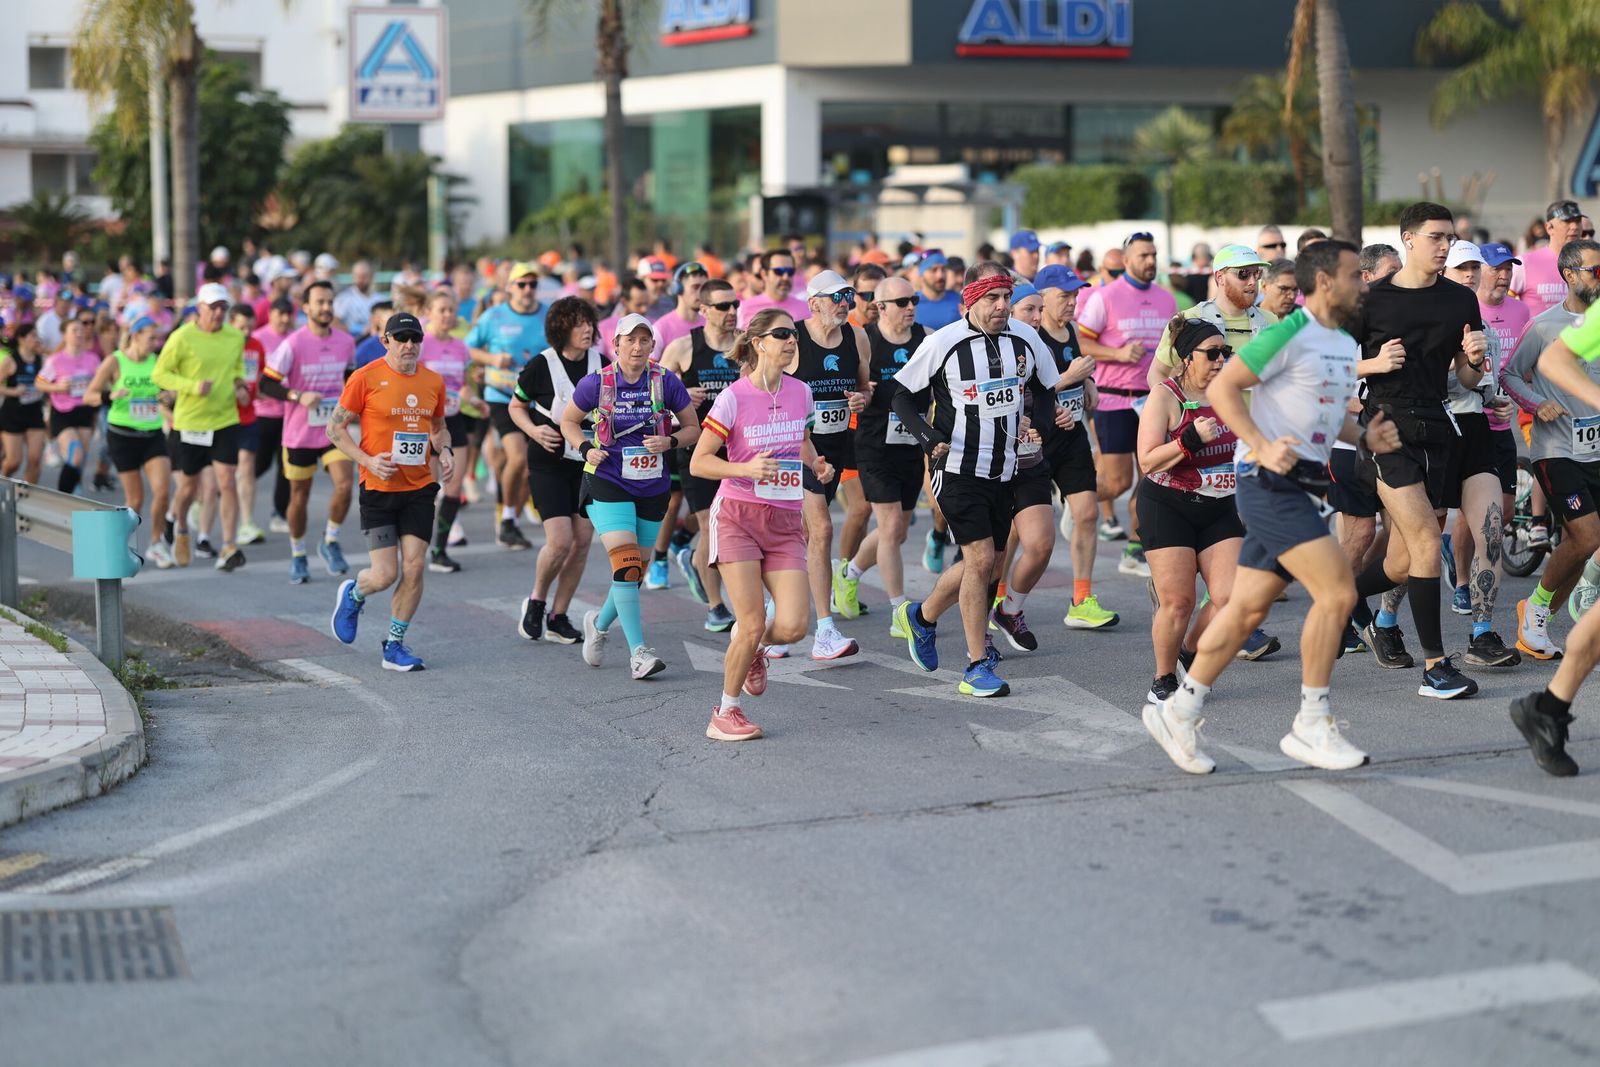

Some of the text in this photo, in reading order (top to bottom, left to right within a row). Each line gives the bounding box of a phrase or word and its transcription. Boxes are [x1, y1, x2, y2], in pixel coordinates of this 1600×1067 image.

[957, 0, 1133, 46] ALDI
[985, 388, 1014, 406] 648
[391, 407, 432, 416] BENIDORM
[402, 415, 420, 423] HALF
[821, 408, 846, 424] 930
[743, 422, 771, 438] MEDIA
[400, 442, 424, 456] 338
[629, 455, 658, 470] 492
